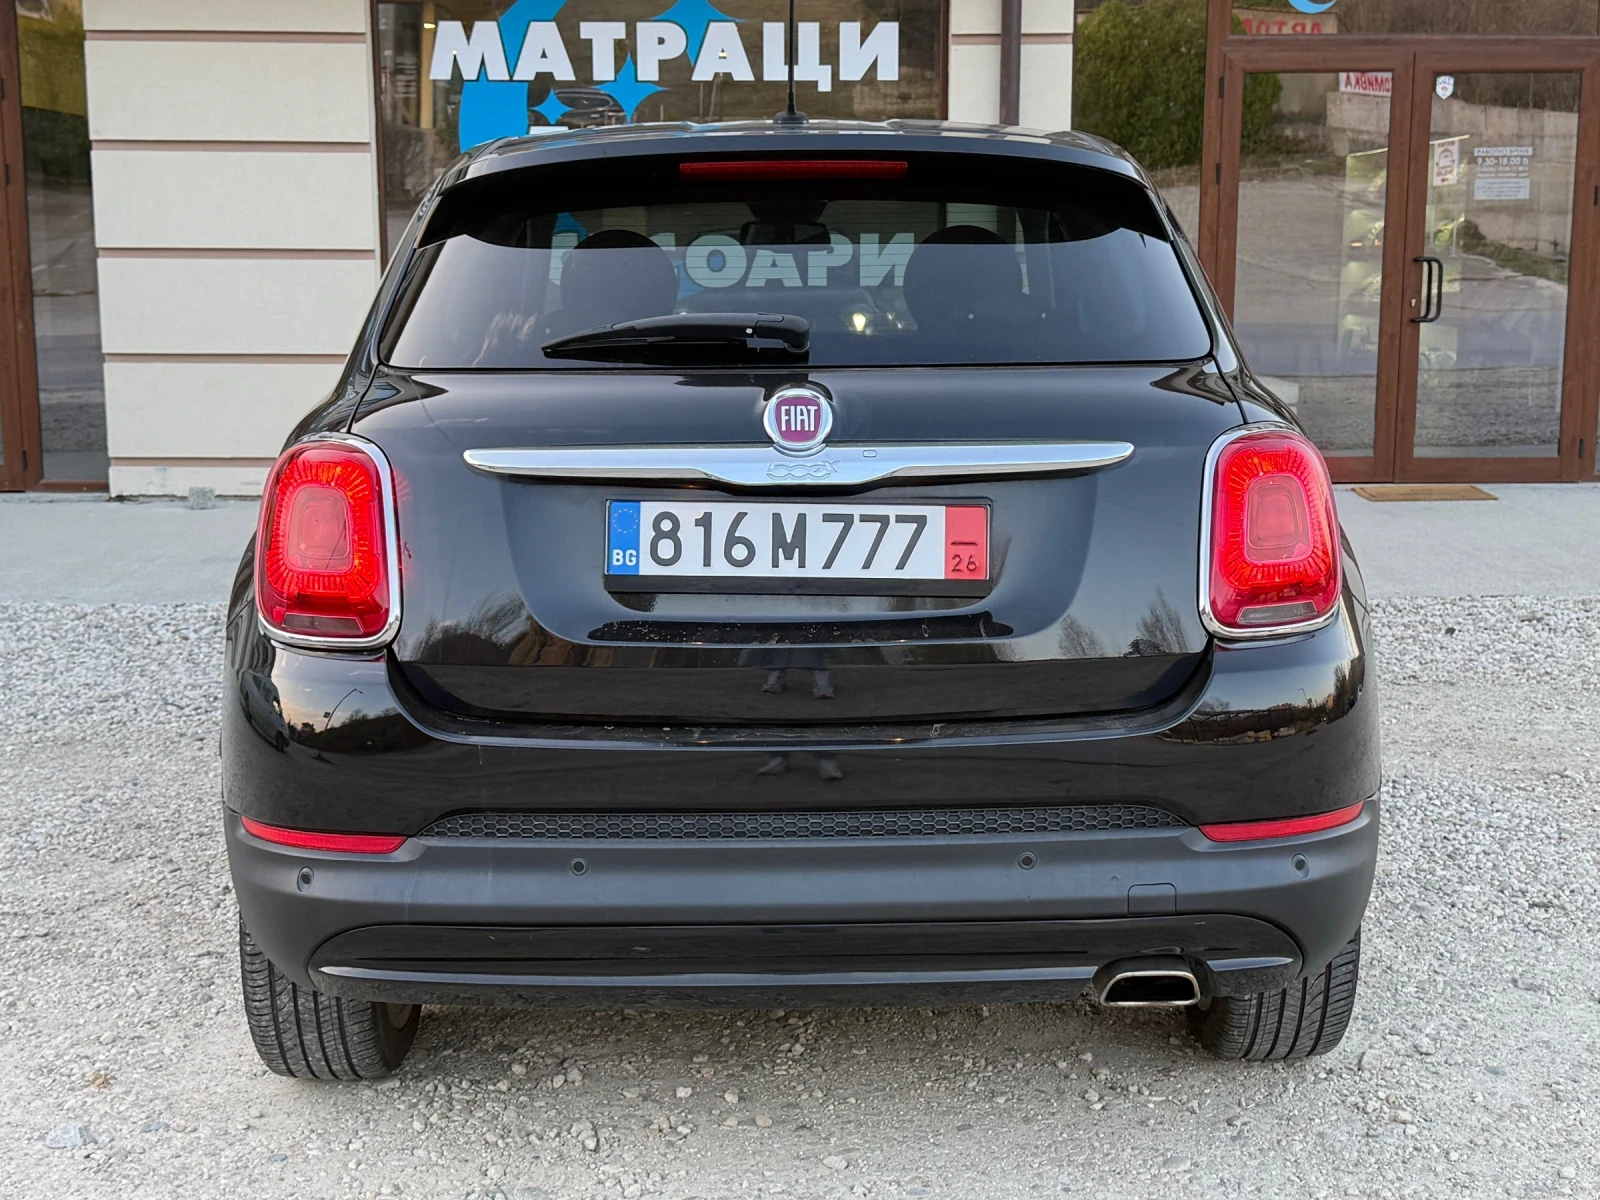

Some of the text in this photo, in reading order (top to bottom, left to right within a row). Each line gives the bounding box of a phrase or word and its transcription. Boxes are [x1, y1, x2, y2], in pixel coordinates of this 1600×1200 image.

[429, 21, 899, 92] МАТРАЦИ
[781, 405, 819, 431] FIAT
[612, 549, 637, 566] BG
[951, 554, 977, 572] 26
